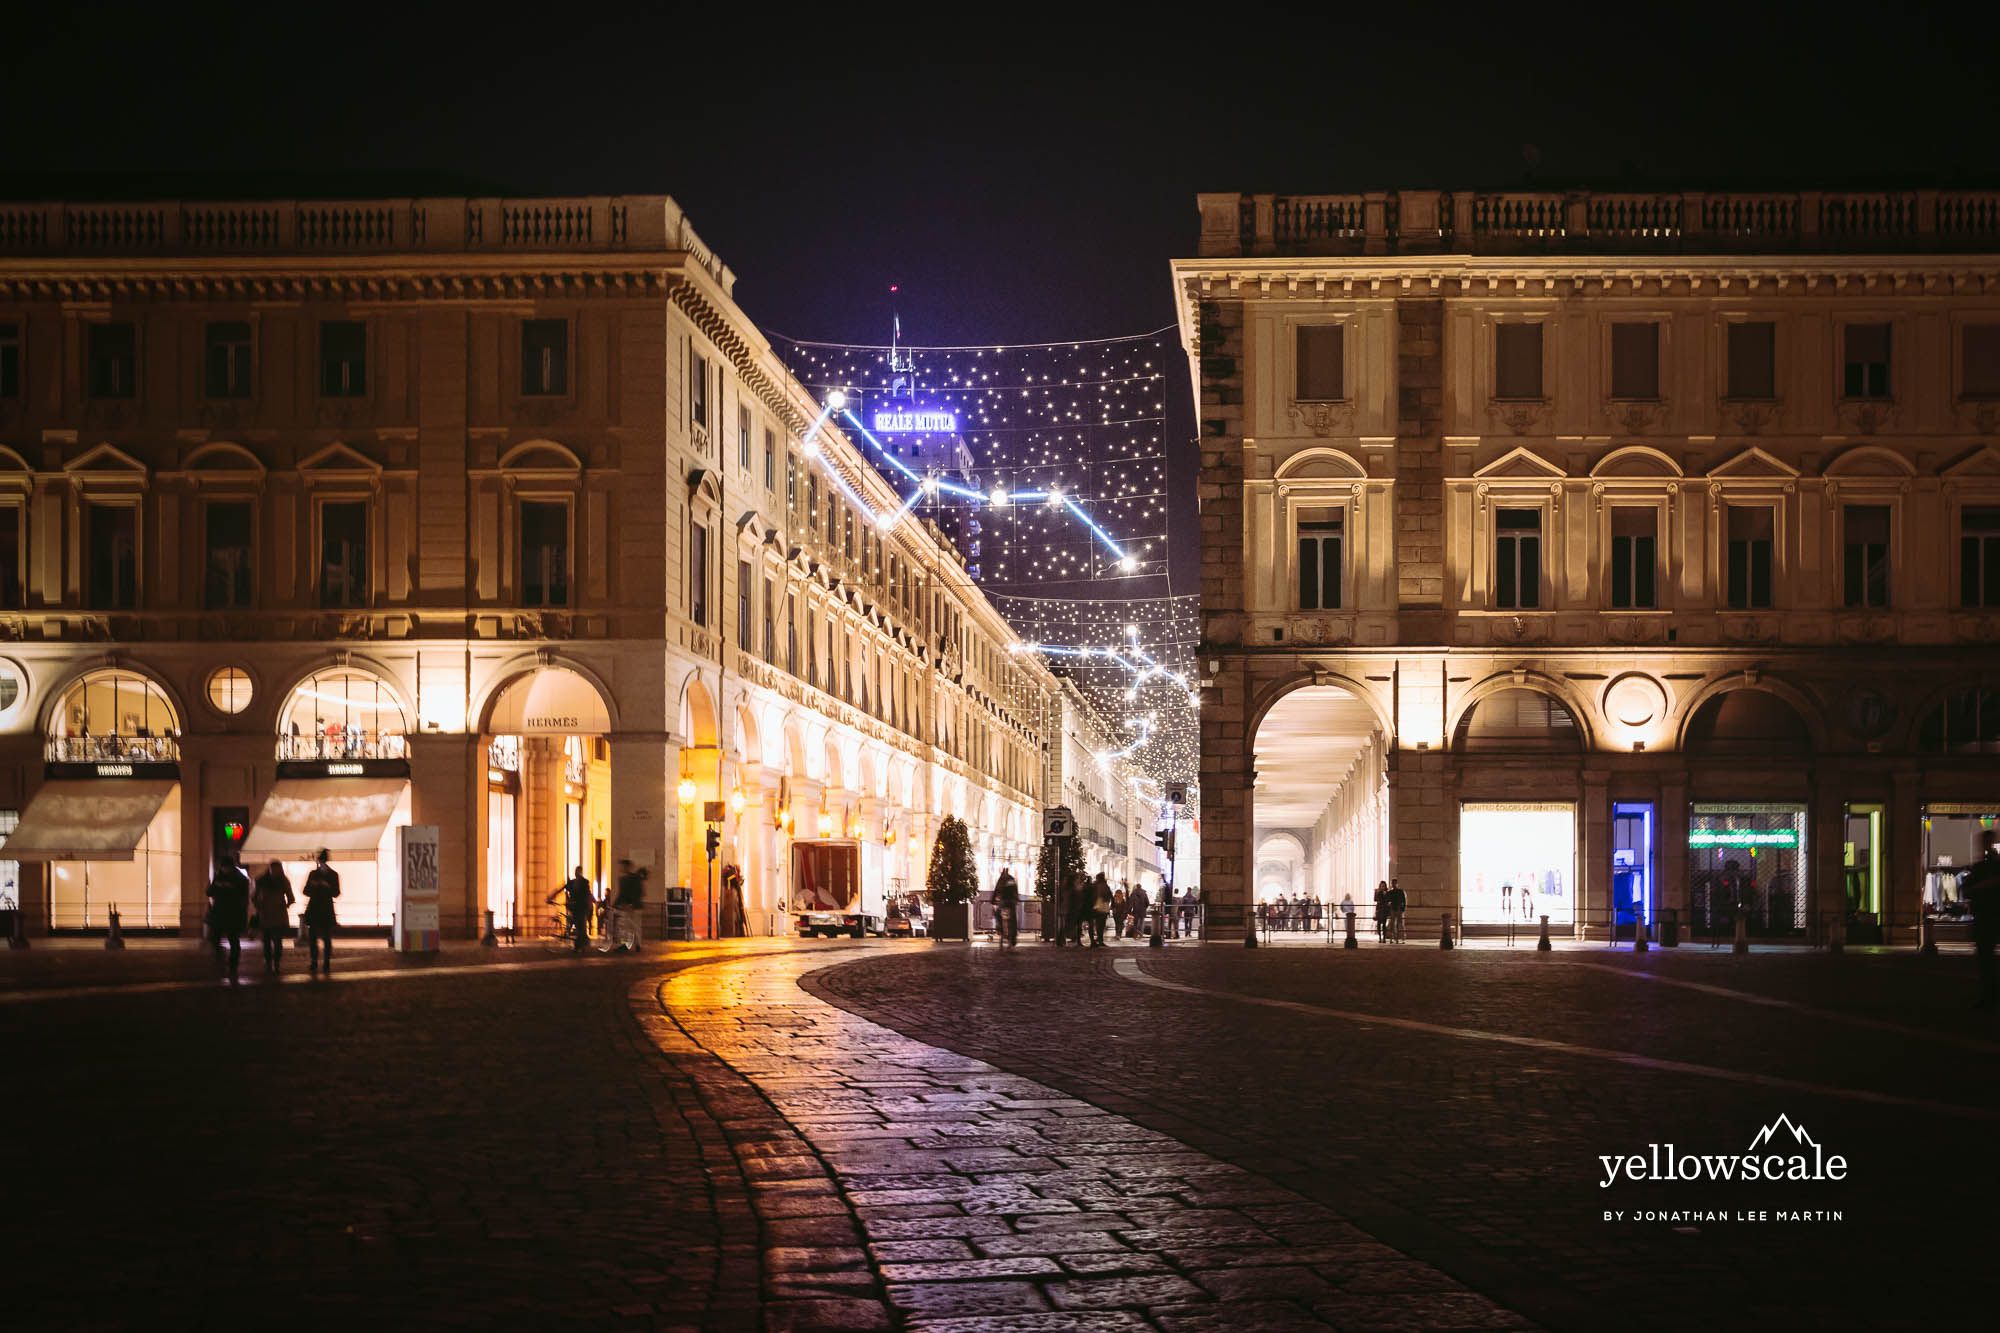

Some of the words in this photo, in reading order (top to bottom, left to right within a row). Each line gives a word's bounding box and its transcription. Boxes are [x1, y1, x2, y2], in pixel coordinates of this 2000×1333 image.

[876, 412, 914, 432] REALE
[914, 412, 956, 432] MUTUA
[408, 842, 437, 857] FEST
